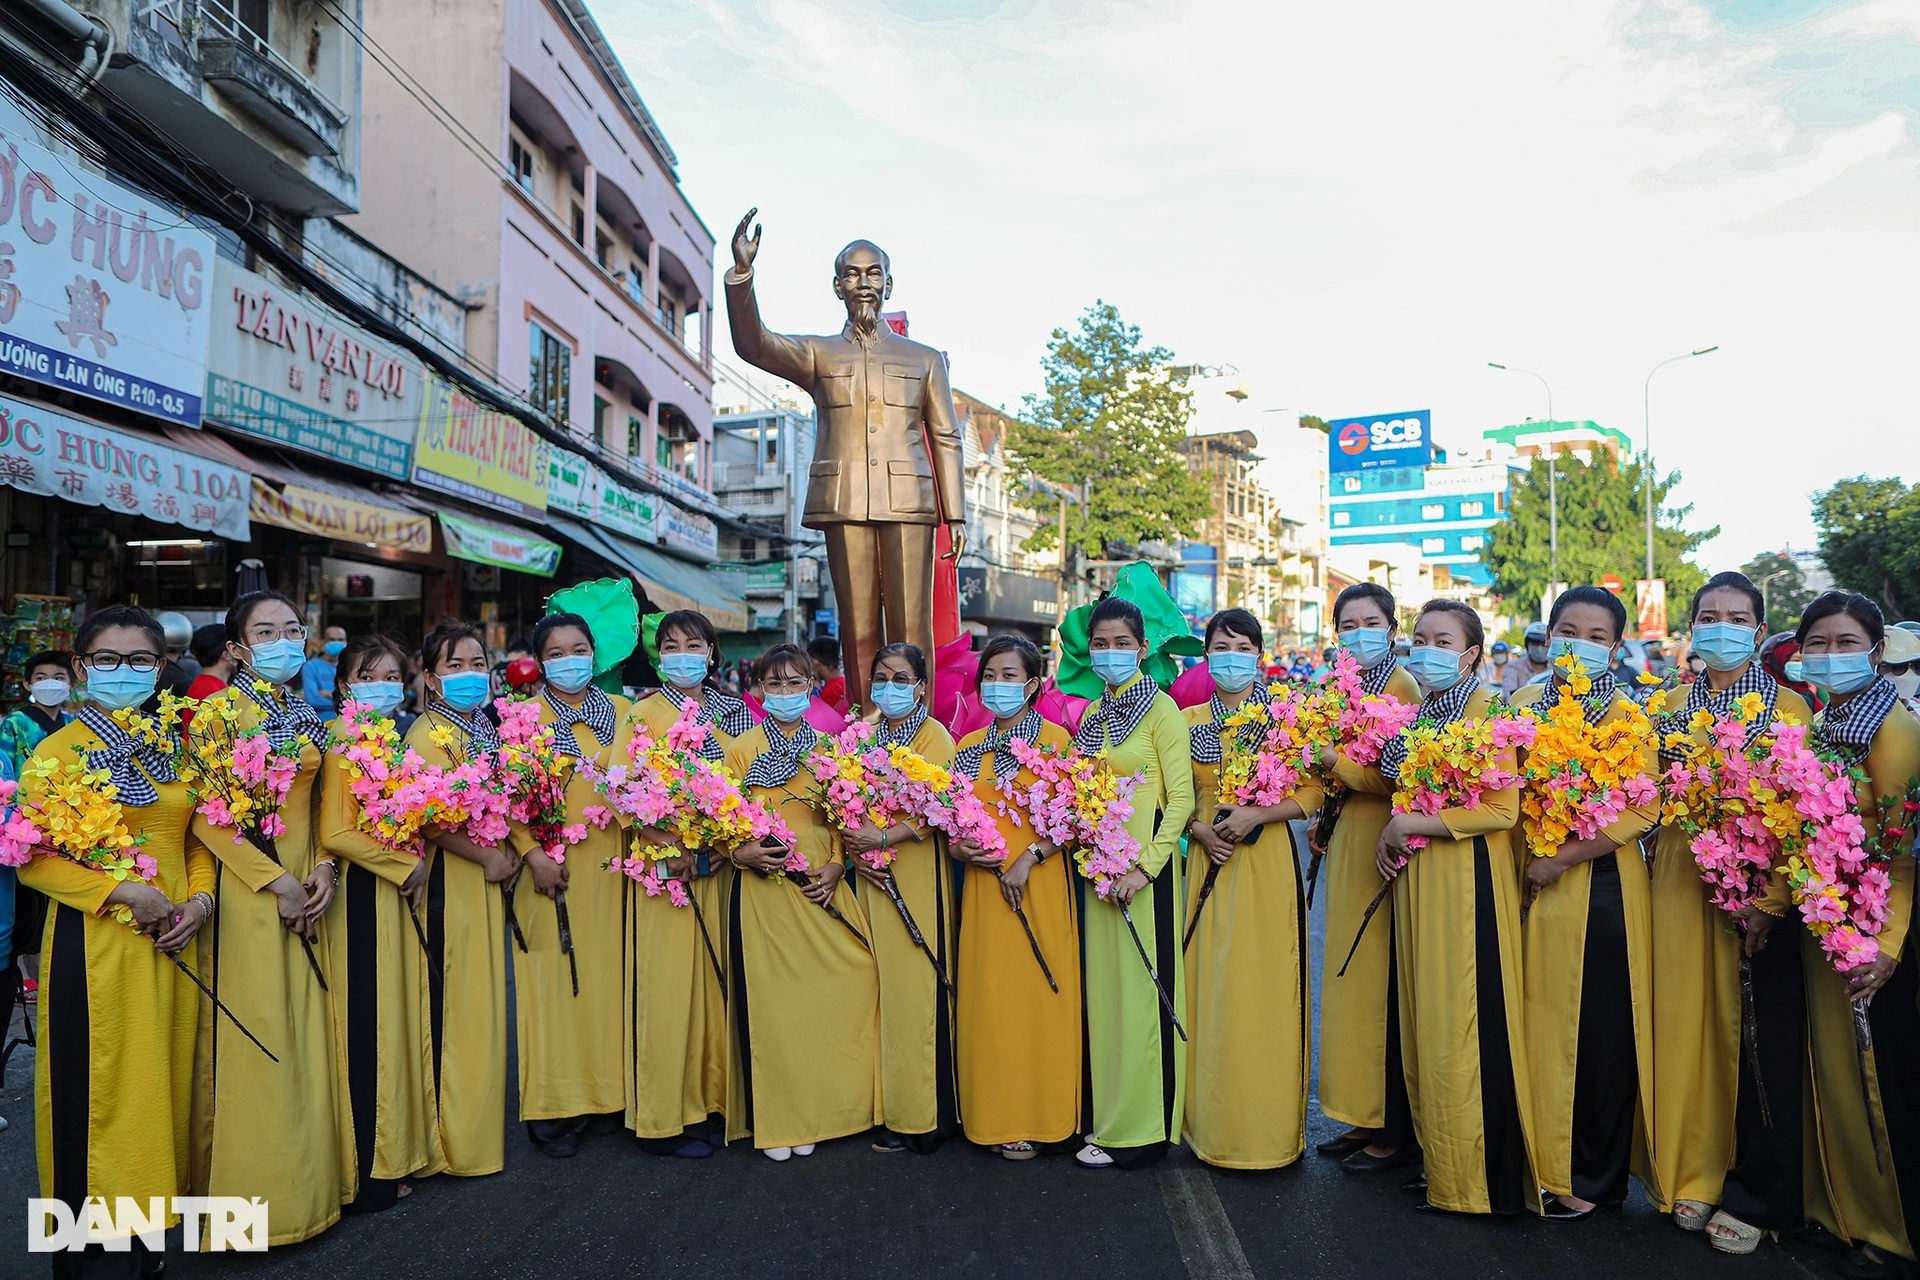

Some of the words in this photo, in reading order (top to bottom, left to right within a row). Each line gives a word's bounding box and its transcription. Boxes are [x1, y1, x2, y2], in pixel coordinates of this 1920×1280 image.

[72, 193, 203, 310] HƯNG
[305, 320, 360, 379] VẠN
[93, 367, 125, 398] ÔNG
[232, 382, 262, 411] 110
[1370, 418, 1422, 444] SCB
[57, 429, 161, 485] HƯNG
[173, 463, 243, 500] 110A
